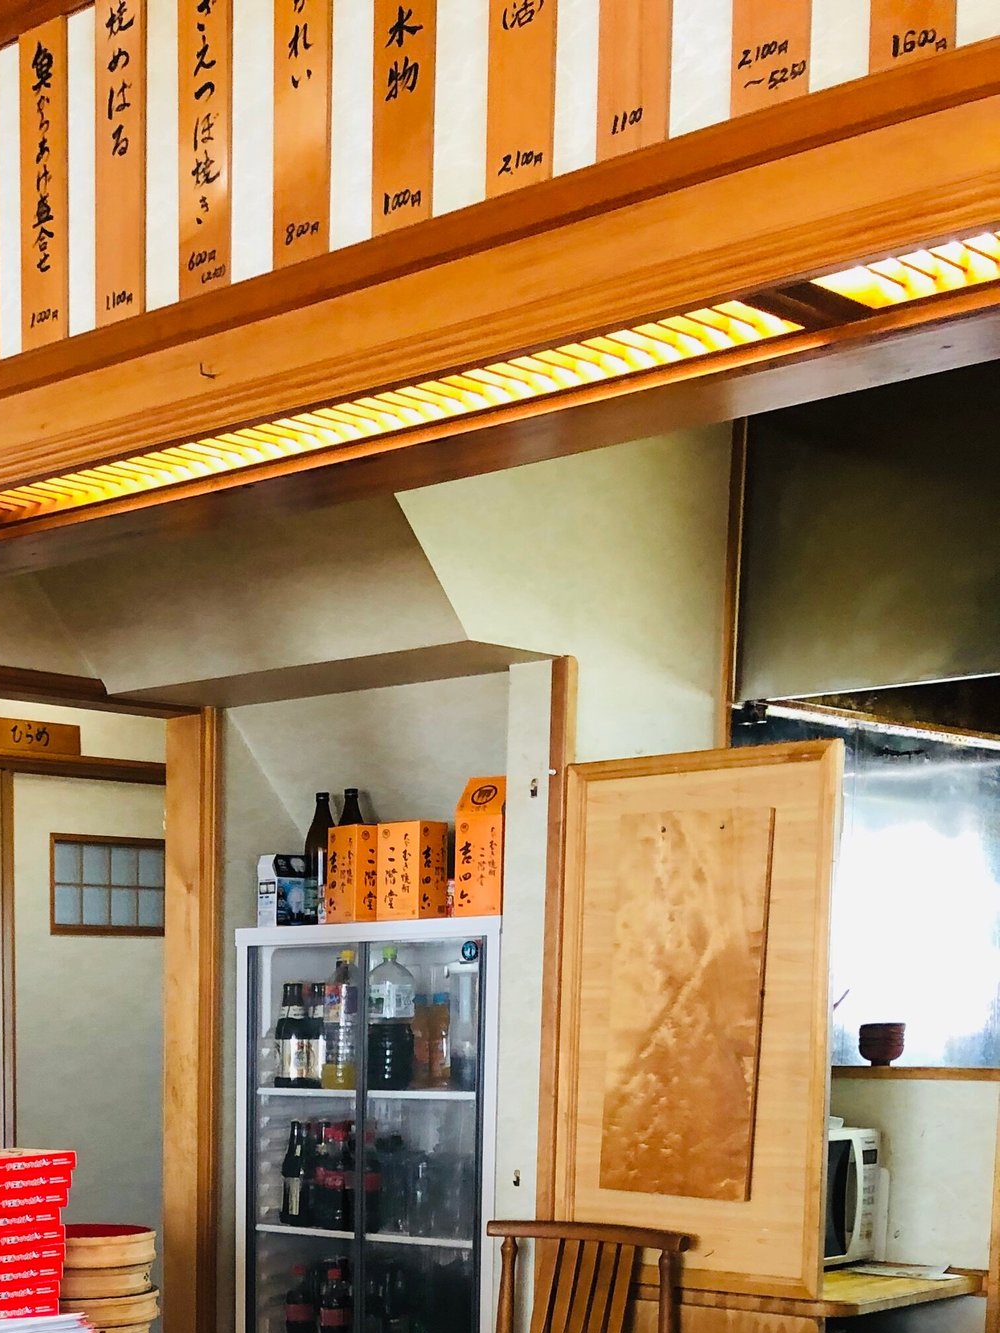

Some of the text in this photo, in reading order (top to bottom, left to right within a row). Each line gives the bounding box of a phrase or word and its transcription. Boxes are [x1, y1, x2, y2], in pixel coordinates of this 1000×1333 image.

[285, 221, 320, 246] 800円
[188, 249, 217, 271] 600円
[10, 723, 50, 747] ひらめ
